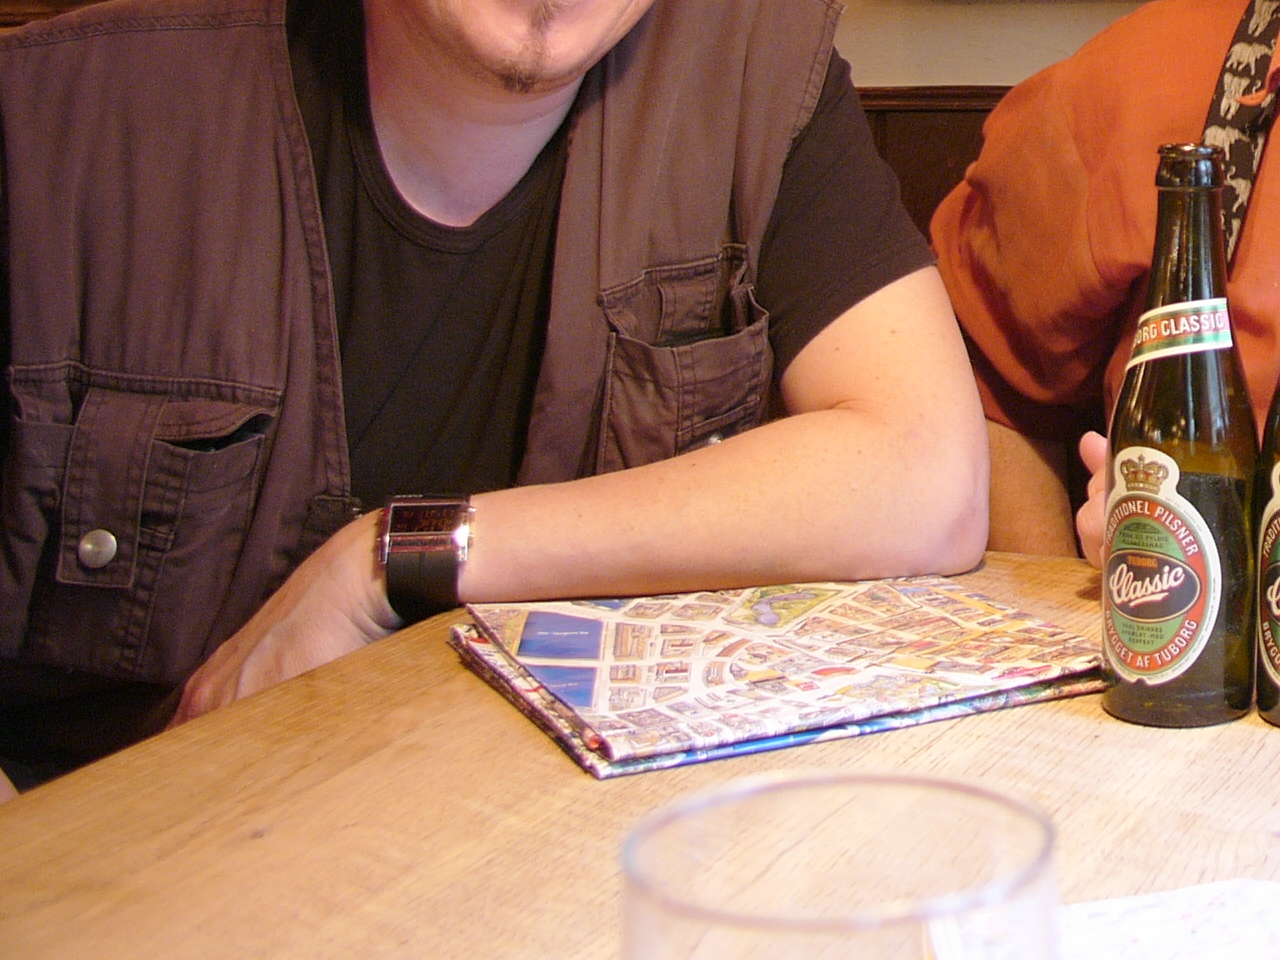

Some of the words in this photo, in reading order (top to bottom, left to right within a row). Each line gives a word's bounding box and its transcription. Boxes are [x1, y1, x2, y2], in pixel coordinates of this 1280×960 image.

[1161, 312, 1225, 336] CLASSIC
[1107, 500, 1151, 546] TRADITIONEL
[1154, 506, 1199, 556] PILSNER
[1109, 563, 1185, 605] Classic
[1136, 655, 1150, 668] AF
[1153, 619, 1197, 665] TUBORG
